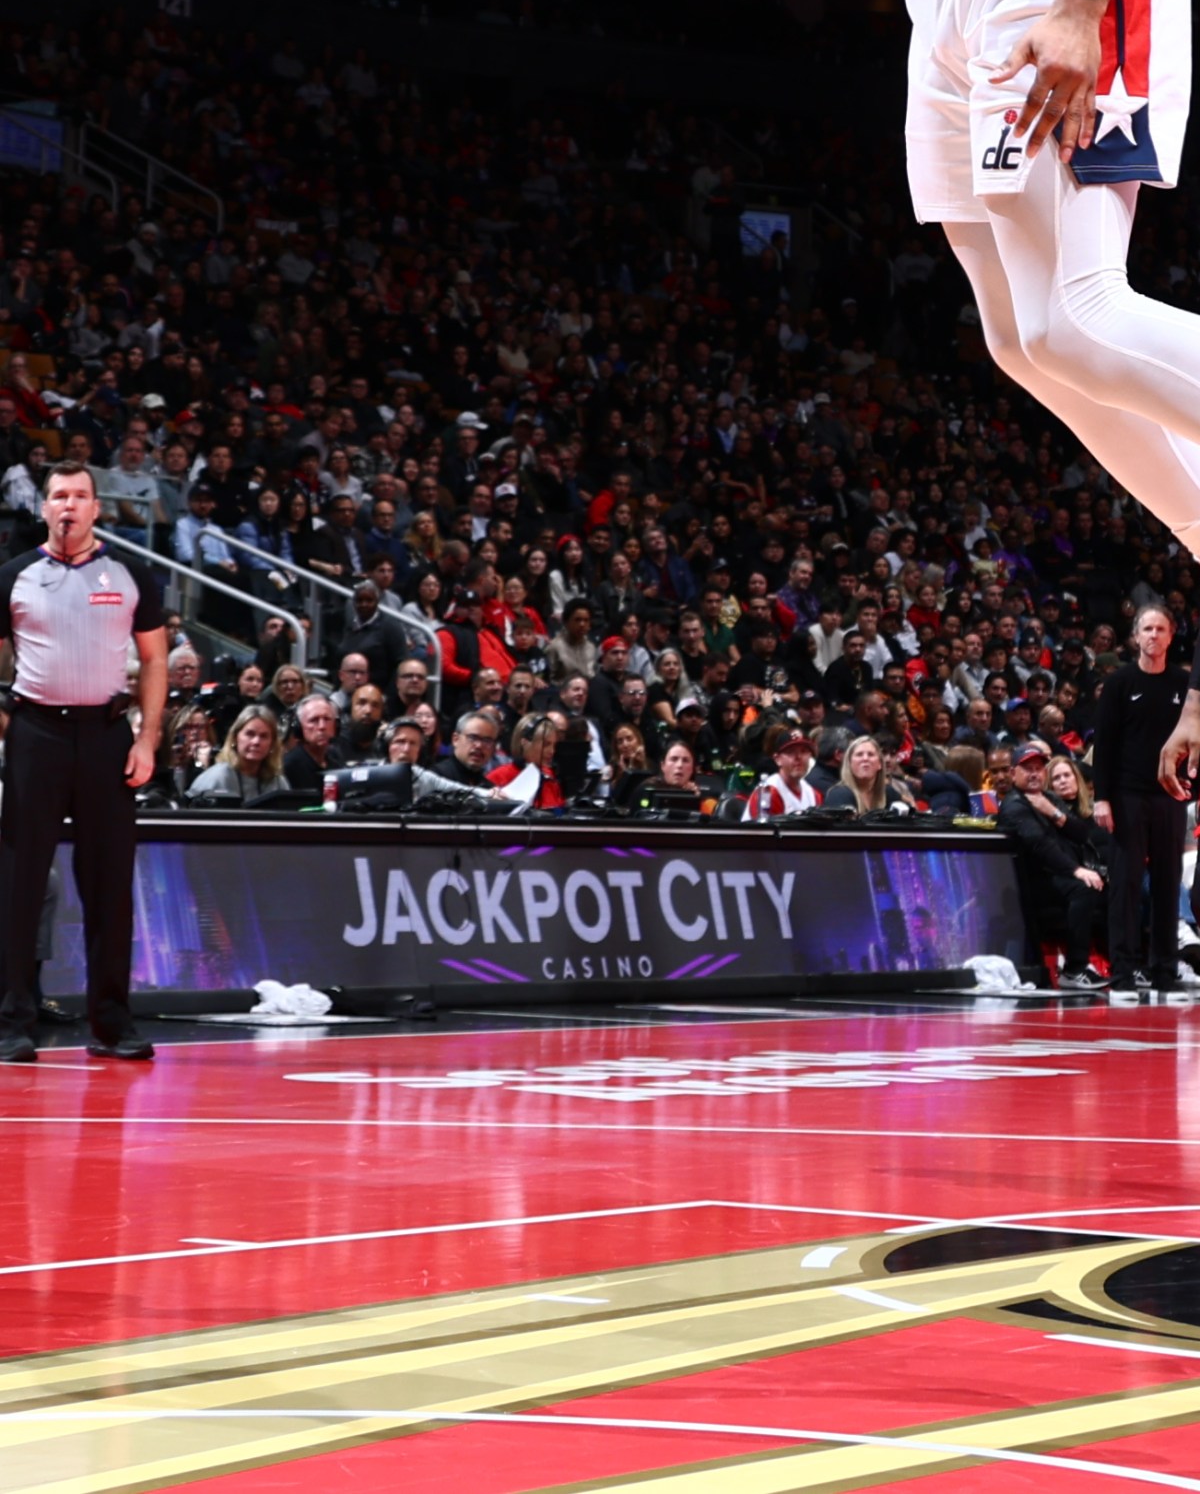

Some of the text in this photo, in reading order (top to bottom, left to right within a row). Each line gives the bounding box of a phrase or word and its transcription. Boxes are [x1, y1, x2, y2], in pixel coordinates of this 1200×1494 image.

[982, 125, 1023, 170] dc
[342, 857, 796, 948] JACKPOT CITY
[542, 955, 654, 981] CASINO
